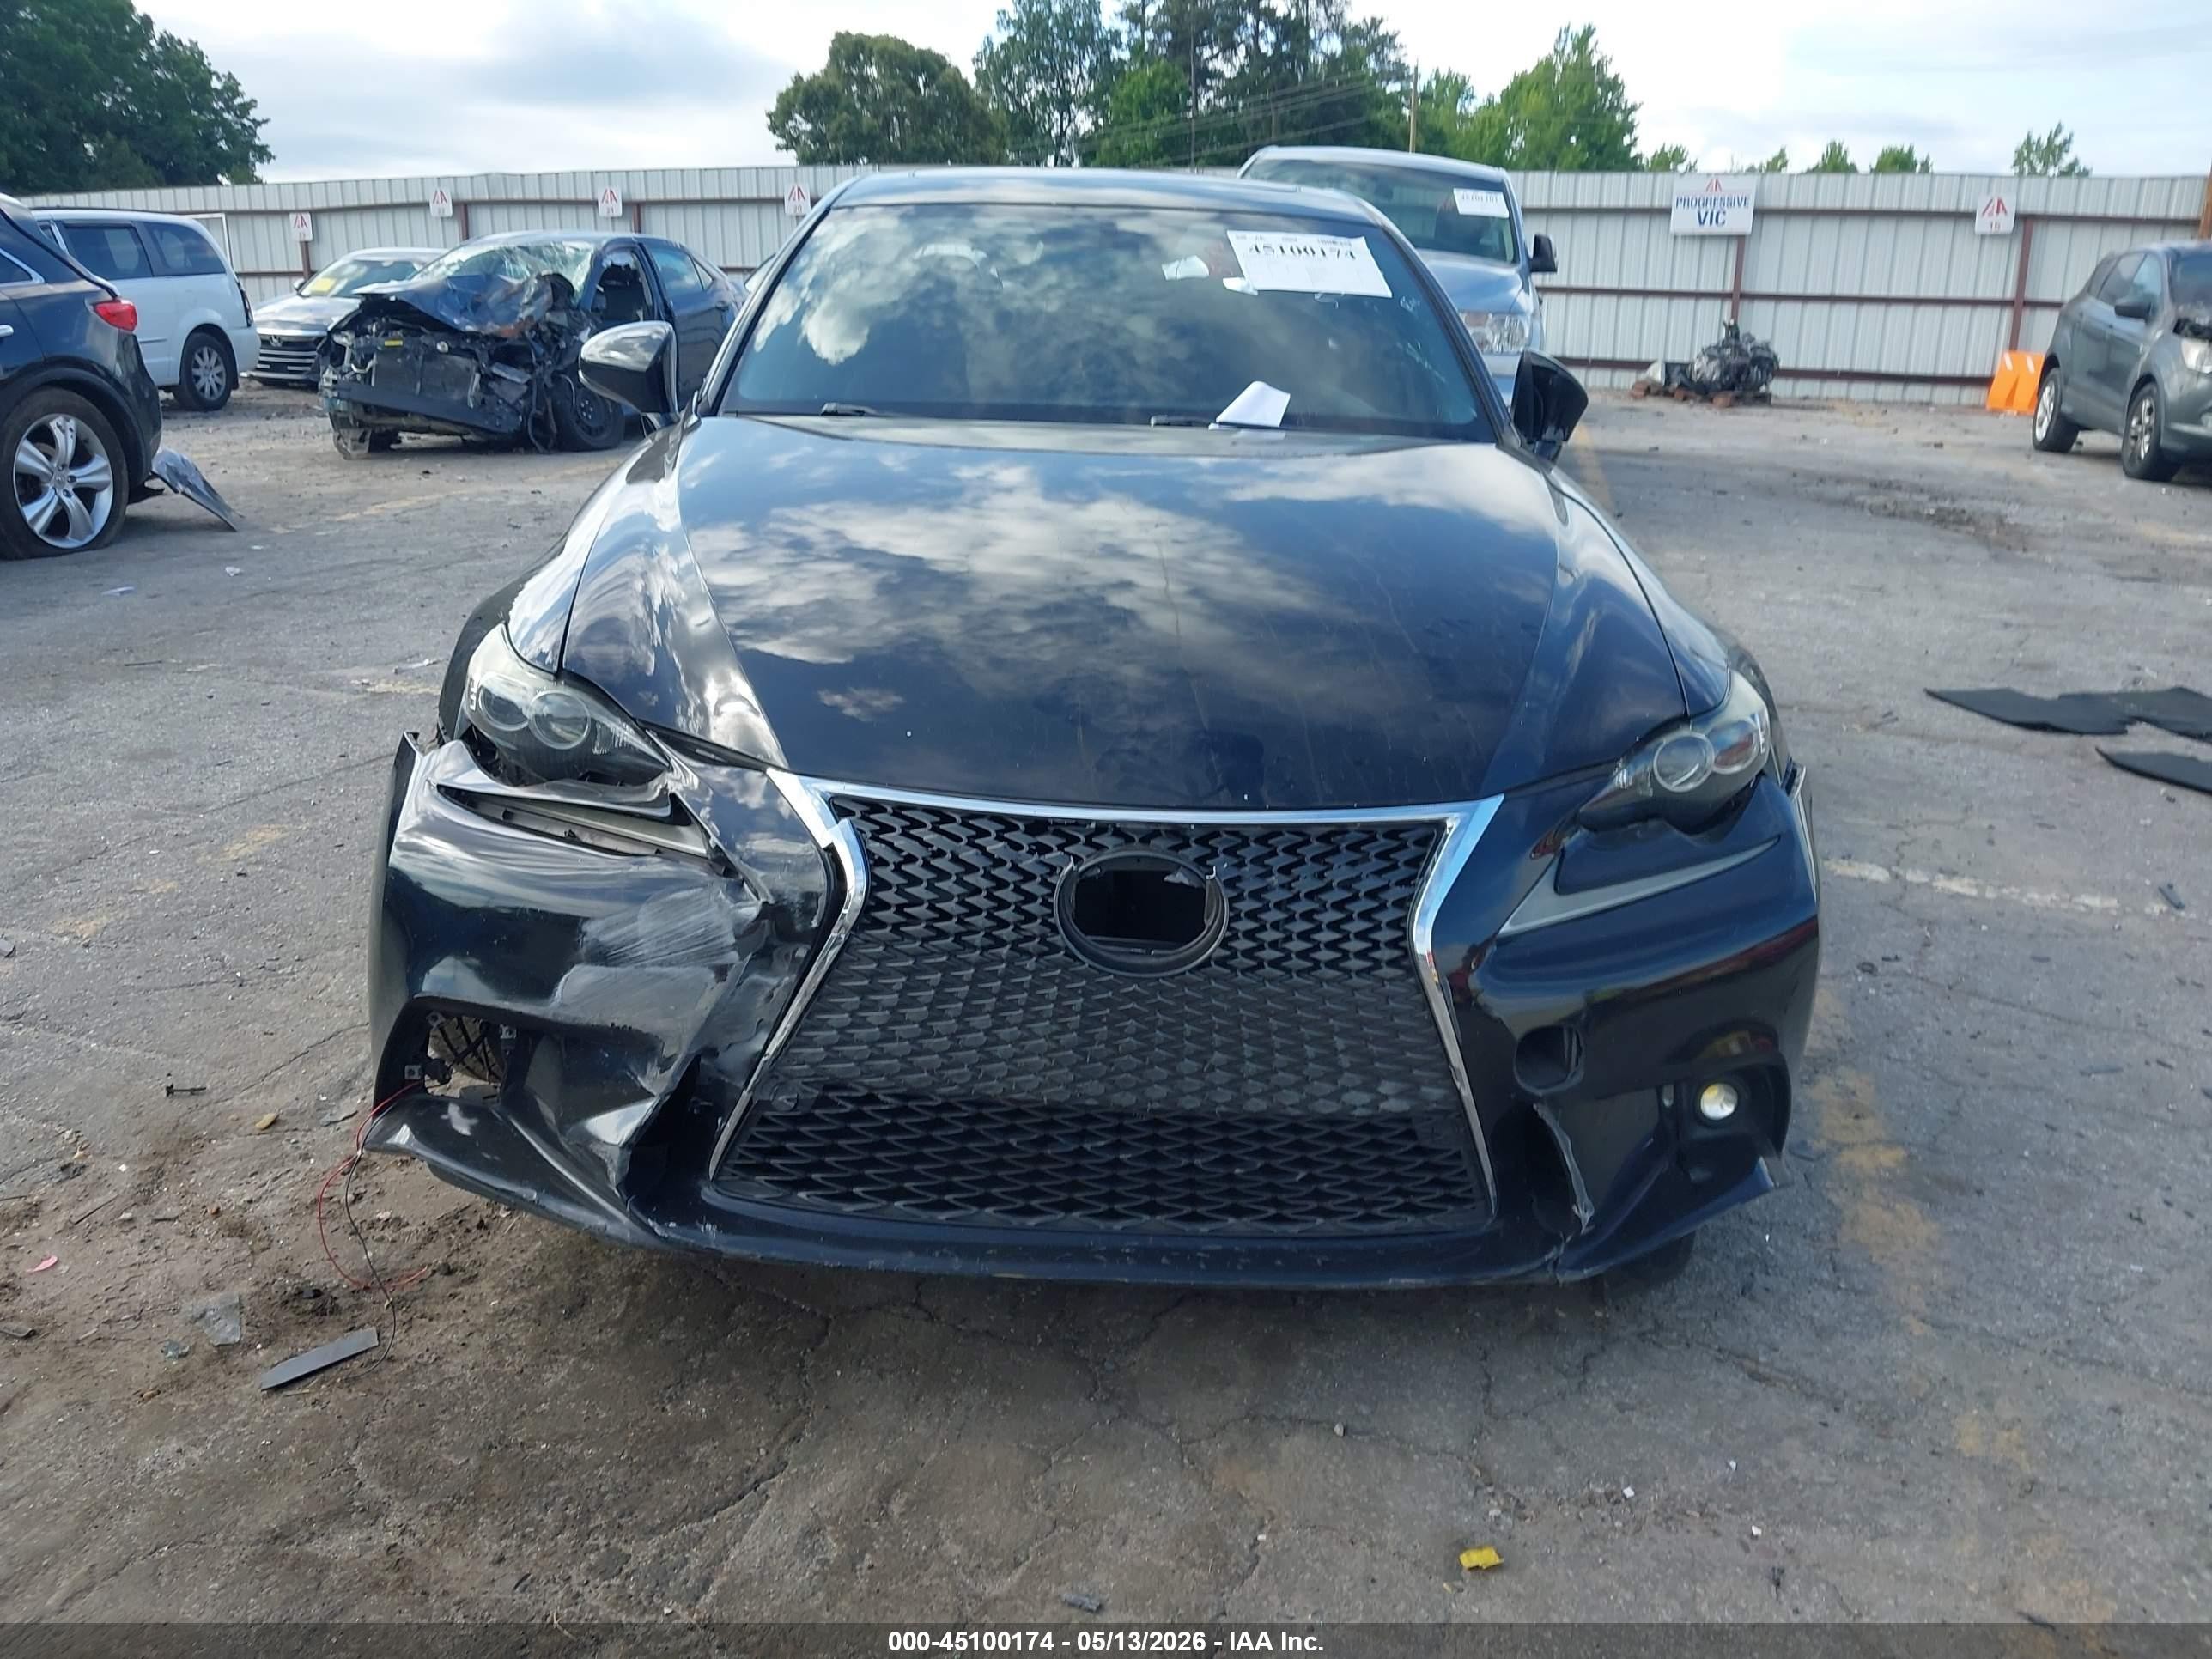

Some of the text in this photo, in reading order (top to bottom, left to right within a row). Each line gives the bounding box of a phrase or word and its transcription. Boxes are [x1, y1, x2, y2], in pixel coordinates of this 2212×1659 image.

[1676, 195, 1751, 209] PROGRESSIVE
[1697, 210, 1726, 226] VIC
[1249, 243, 1357, 260] 45100174
